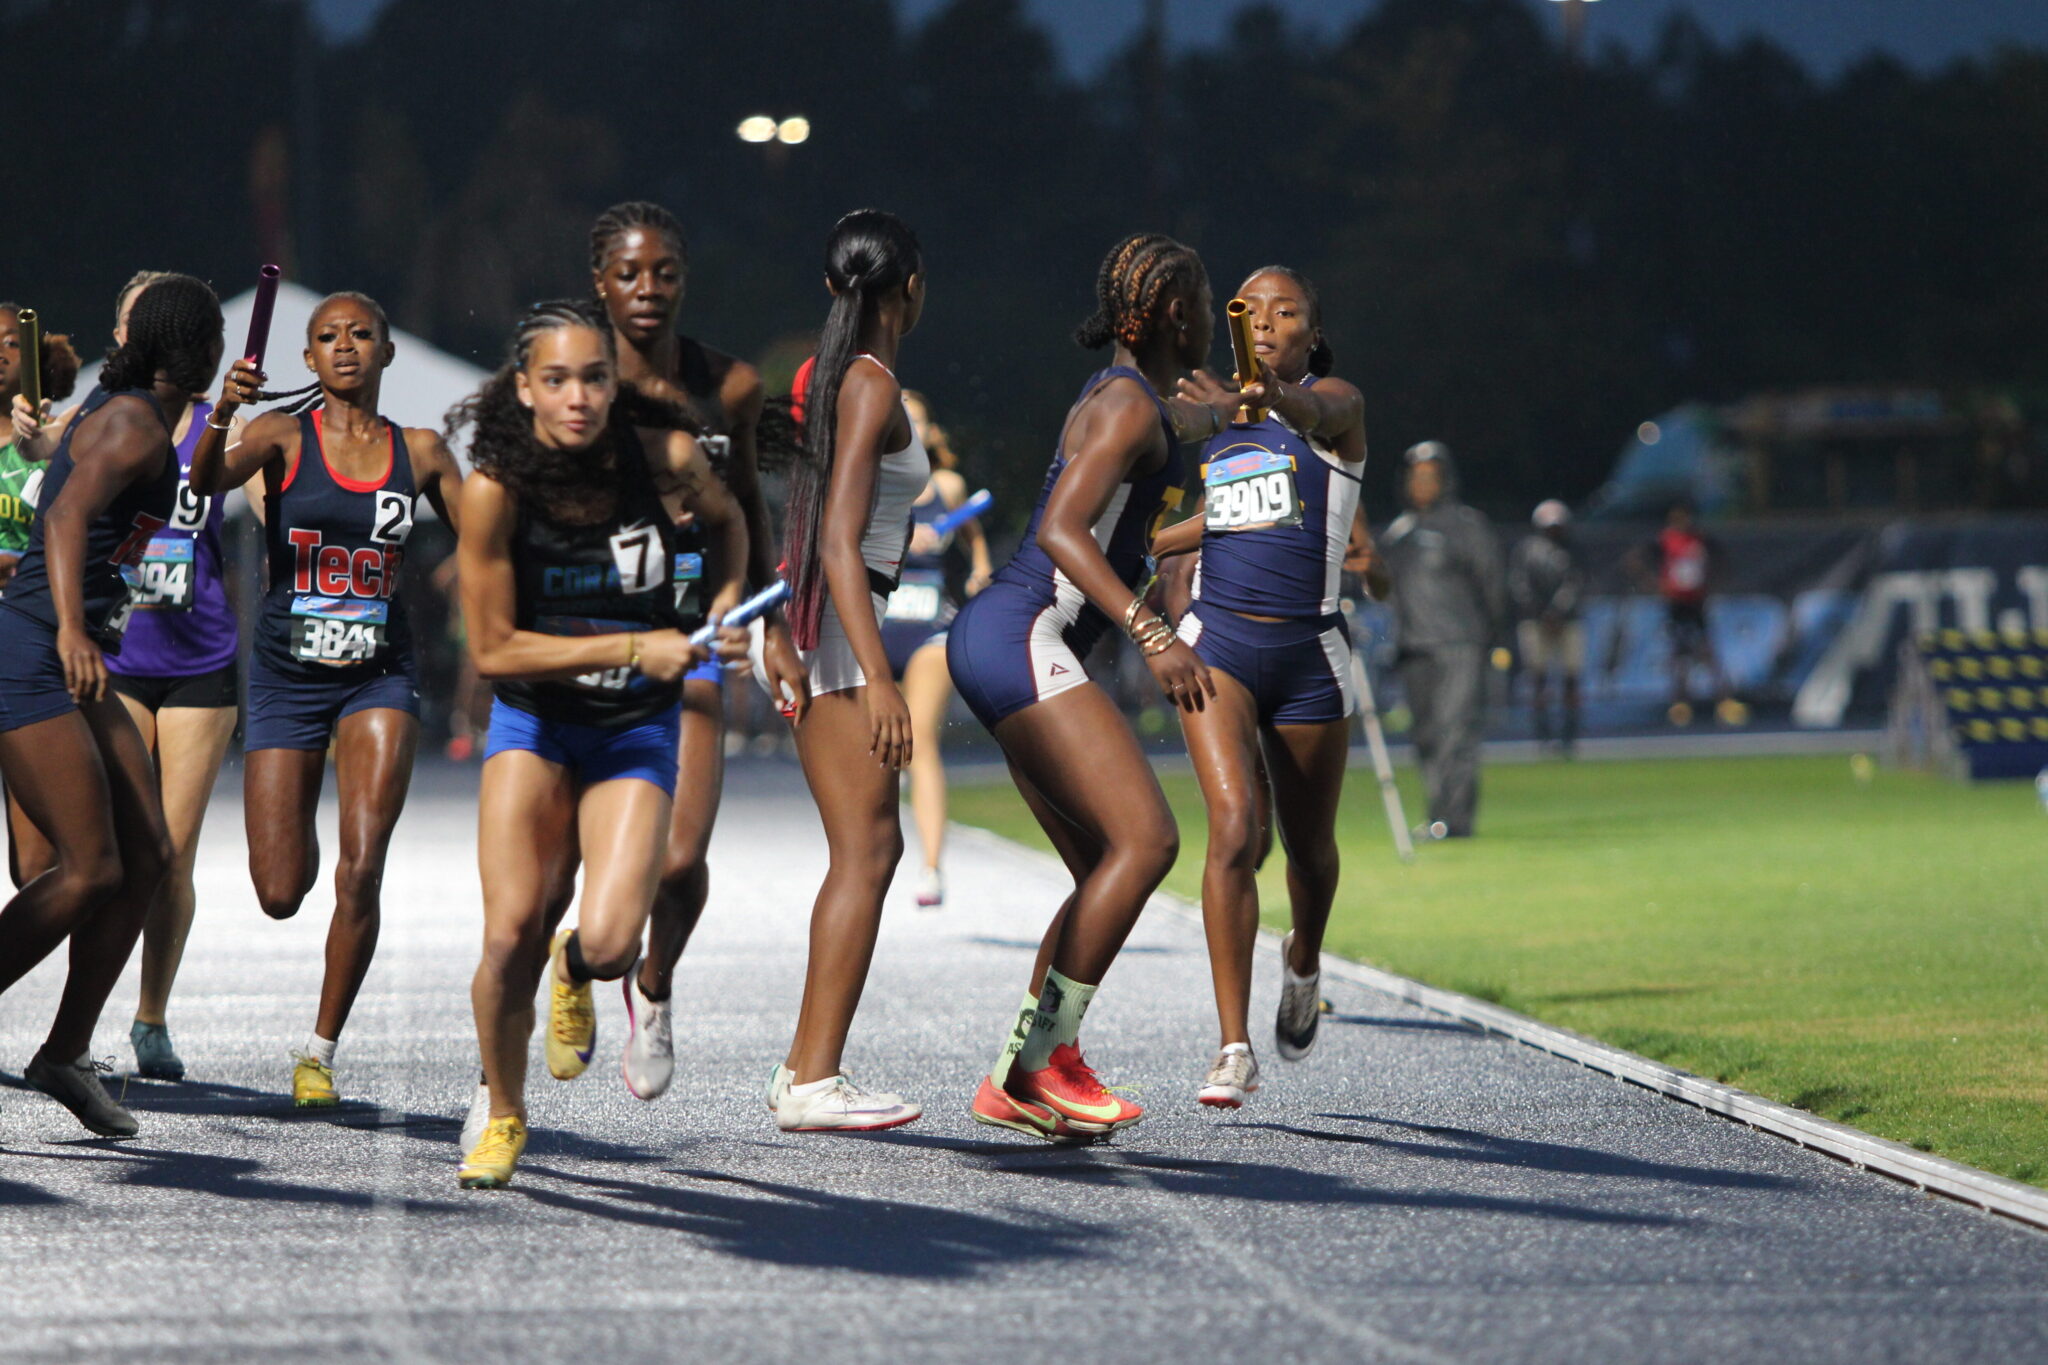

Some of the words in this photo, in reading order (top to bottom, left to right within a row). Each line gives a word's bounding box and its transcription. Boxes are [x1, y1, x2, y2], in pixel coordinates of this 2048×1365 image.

[179, 485, 206, 525] 9
[376, 497, 406, 541] 2
[1206, 472, 1291, 526] 3909
[618, 533, 651, 588] 7
